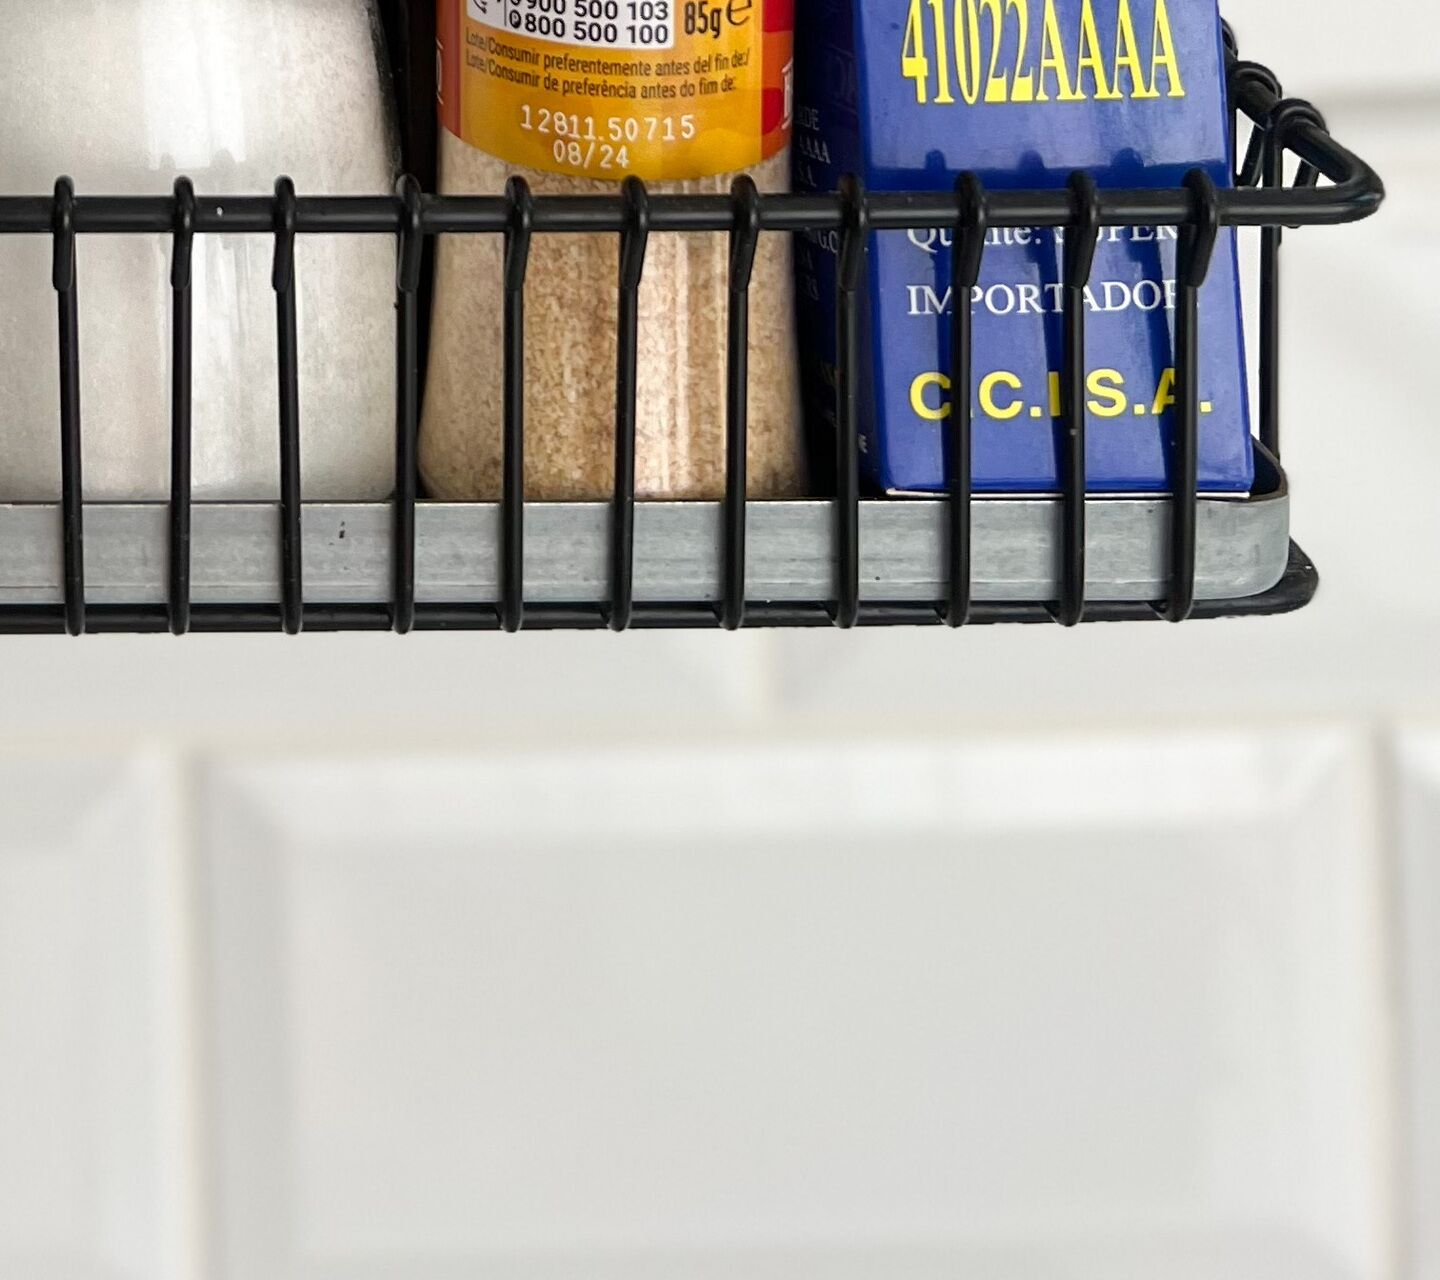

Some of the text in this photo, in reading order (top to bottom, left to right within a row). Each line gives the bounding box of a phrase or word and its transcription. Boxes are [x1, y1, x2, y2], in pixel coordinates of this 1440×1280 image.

[574, 0, 619, 21] 500
[628, 1, 669, 22] 103
[684, 0, 721, 38] 85g
[524, 14, 566, 38] 800
[573, 21, 618, 44] 500
[627, 24, 669, 44] 100
[544, 50, 651, 77] preferentemente
[655, 57, 690, 76] antes
[693, 54, 711, 74] del
[714, 51, 730, 71] fin
[544, 71, 559, 92] de
[562, 76, 637, 101] preferência
[641, 79, 676, 99] antes
[680, 77, 695, 98] do
[699, 75, 718, 95] fim
[553, 140, 629, 169] 08/24
